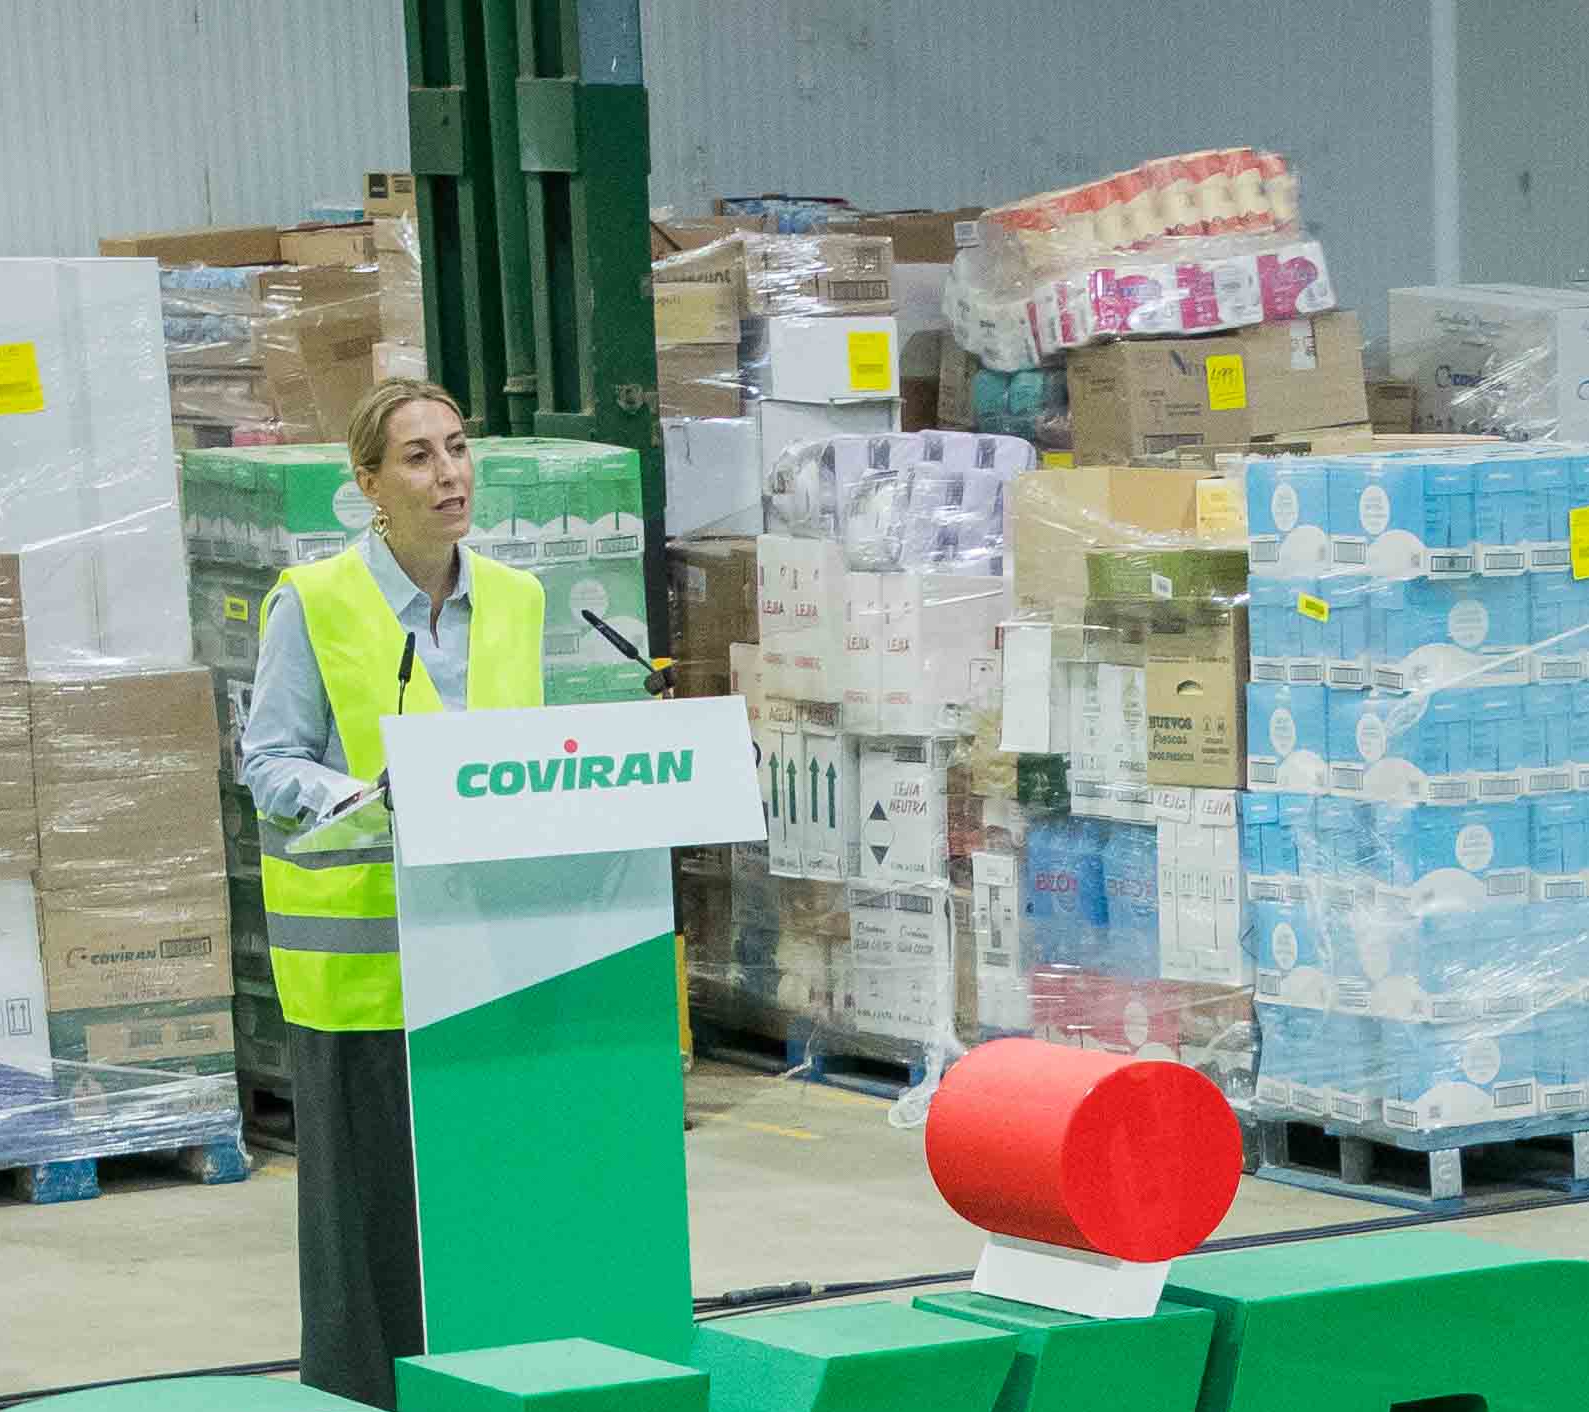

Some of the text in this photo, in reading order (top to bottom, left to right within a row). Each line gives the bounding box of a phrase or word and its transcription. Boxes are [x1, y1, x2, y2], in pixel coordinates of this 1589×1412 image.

[1148, 715, 1194, 731] HUEVOS
[456, 738, 694, 799] COVIRAN
[90, 944, 158, 966] COVIRAN
